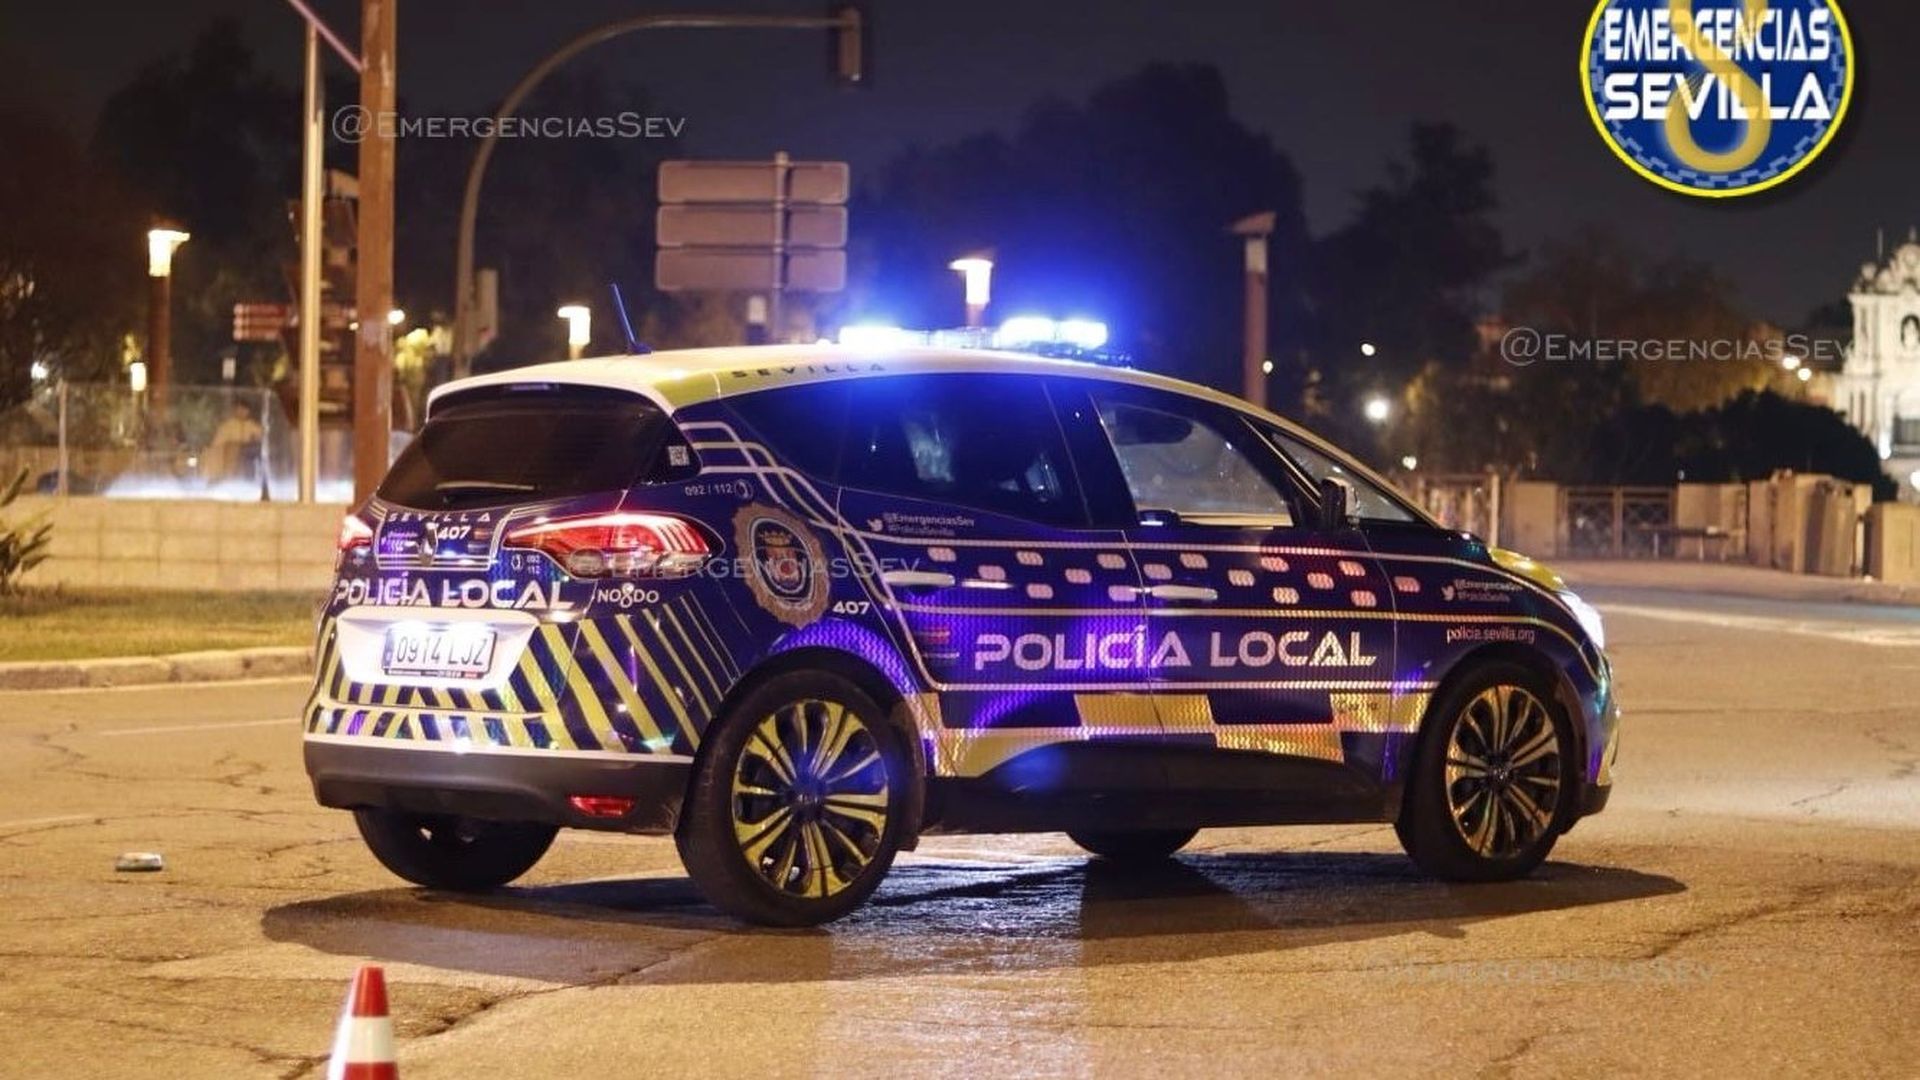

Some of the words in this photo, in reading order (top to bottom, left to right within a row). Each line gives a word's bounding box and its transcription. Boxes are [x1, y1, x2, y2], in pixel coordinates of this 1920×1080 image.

[731, 363, 885, 378] SEVILLA
[685, 485, 705, 497] 092
[714, 482, 733, 496] 112
[388, 512, 491, 522] SEVILLA
[438, 525, 471, 541] 407
[333, 572, 432, 607] POLICÍA
[441, 578, 576, 609] LOCAL
[832, 601, 870, 615] 407
[396, 635, 442, 664] 0914
[447, 637, 489, 667] LJZ
[974, 624, 1192, 671] POLICÍA
[1210, 631, 1377, 668] LOCAL
